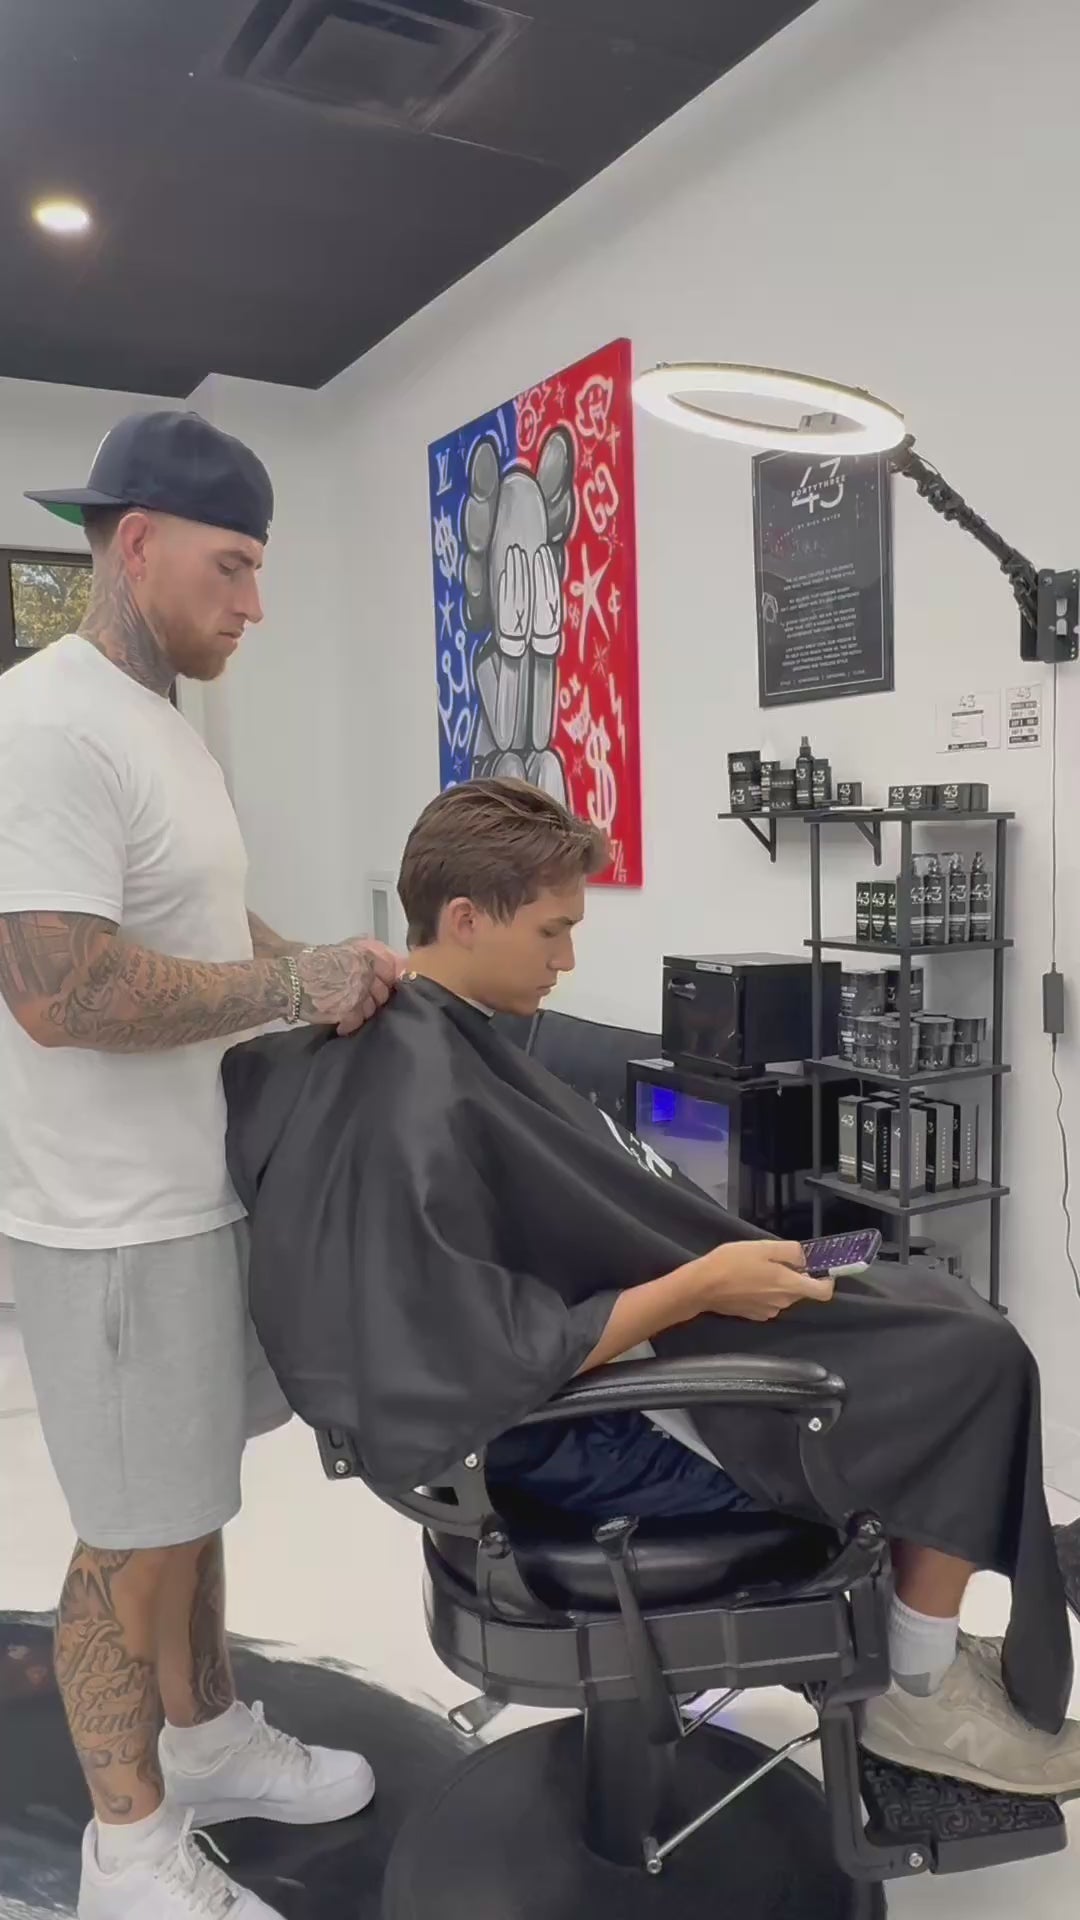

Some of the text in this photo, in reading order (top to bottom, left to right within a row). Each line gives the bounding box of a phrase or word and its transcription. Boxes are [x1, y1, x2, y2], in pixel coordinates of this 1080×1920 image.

[791, 456, 844, 514] 43
[791, 474, 846, 498] FORTYTHREE
[839, 784, 851, 796] 43
[891, 787, 905, 800] 43
[908, 787, 922, 800] 43
[943, 784, 958, 798] 43
[971, 883, 991, 899] 43
[856, 892, 870, 905] 43
[872, 892, 886, 906] 43
[840, 1114, 854, 1128] 43
[863, 1120, 874, 1132] 43
